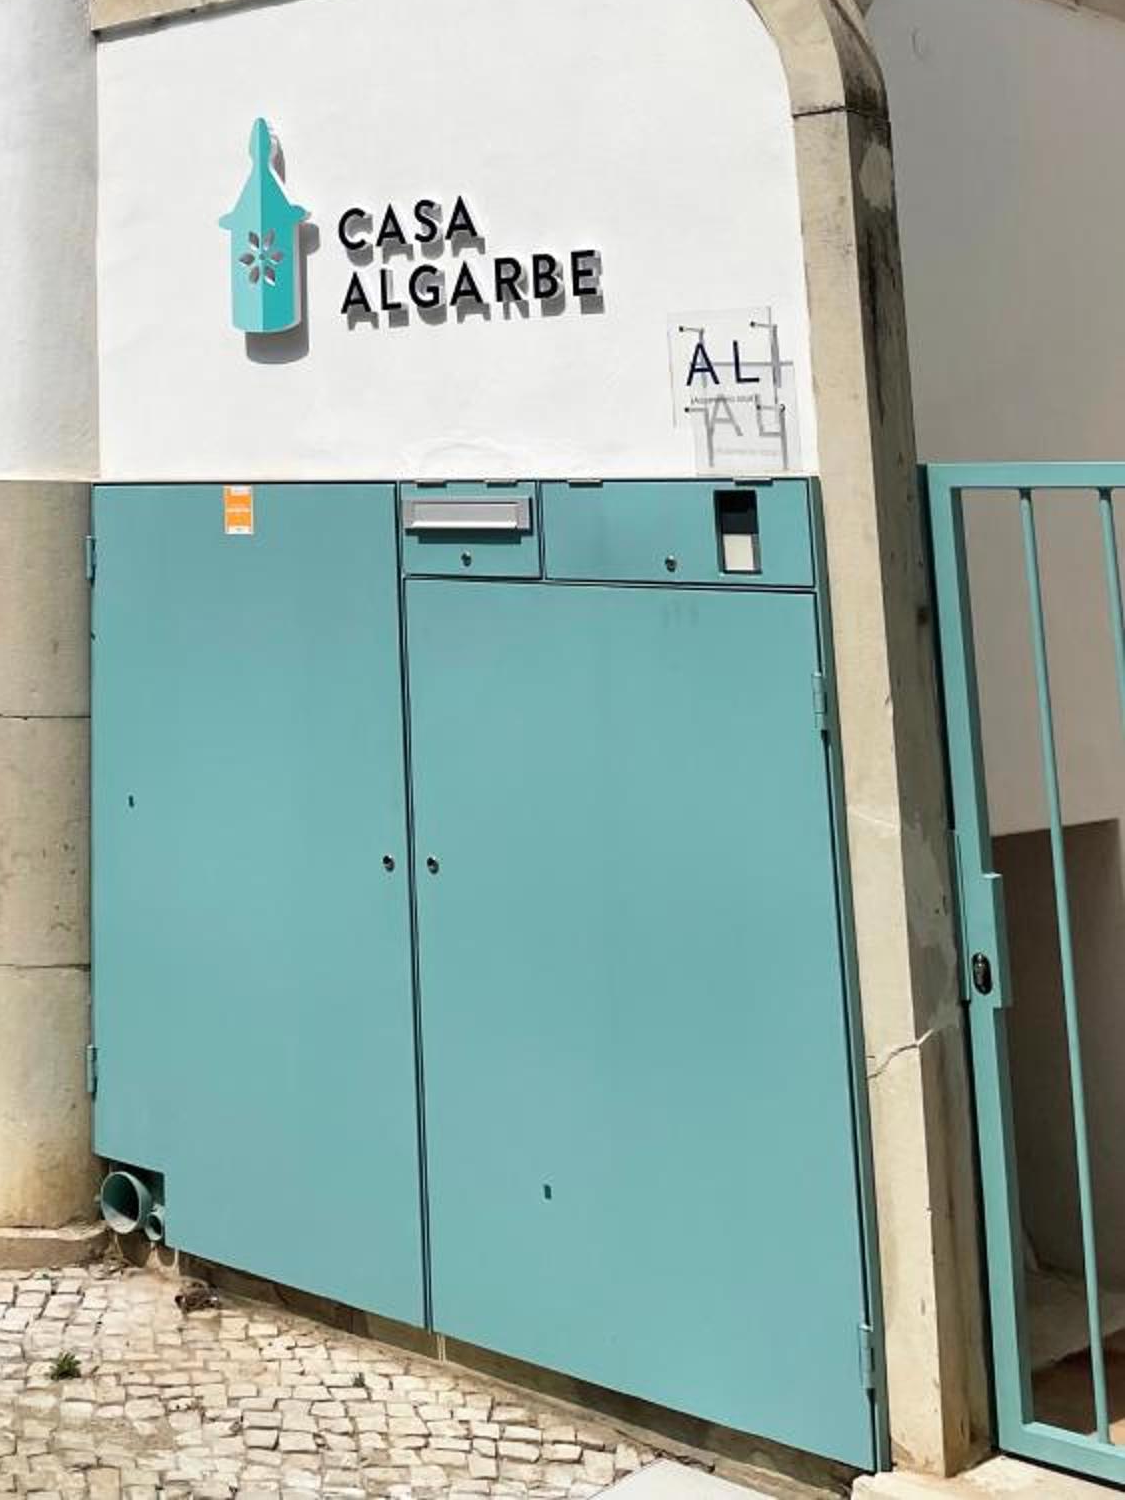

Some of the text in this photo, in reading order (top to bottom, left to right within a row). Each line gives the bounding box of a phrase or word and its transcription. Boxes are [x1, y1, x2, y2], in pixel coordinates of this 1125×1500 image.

[338, 195, 478, 250] CASA
[341, 250, 597, 314] ALGARBE
[686, 340, 760, 386] AL
